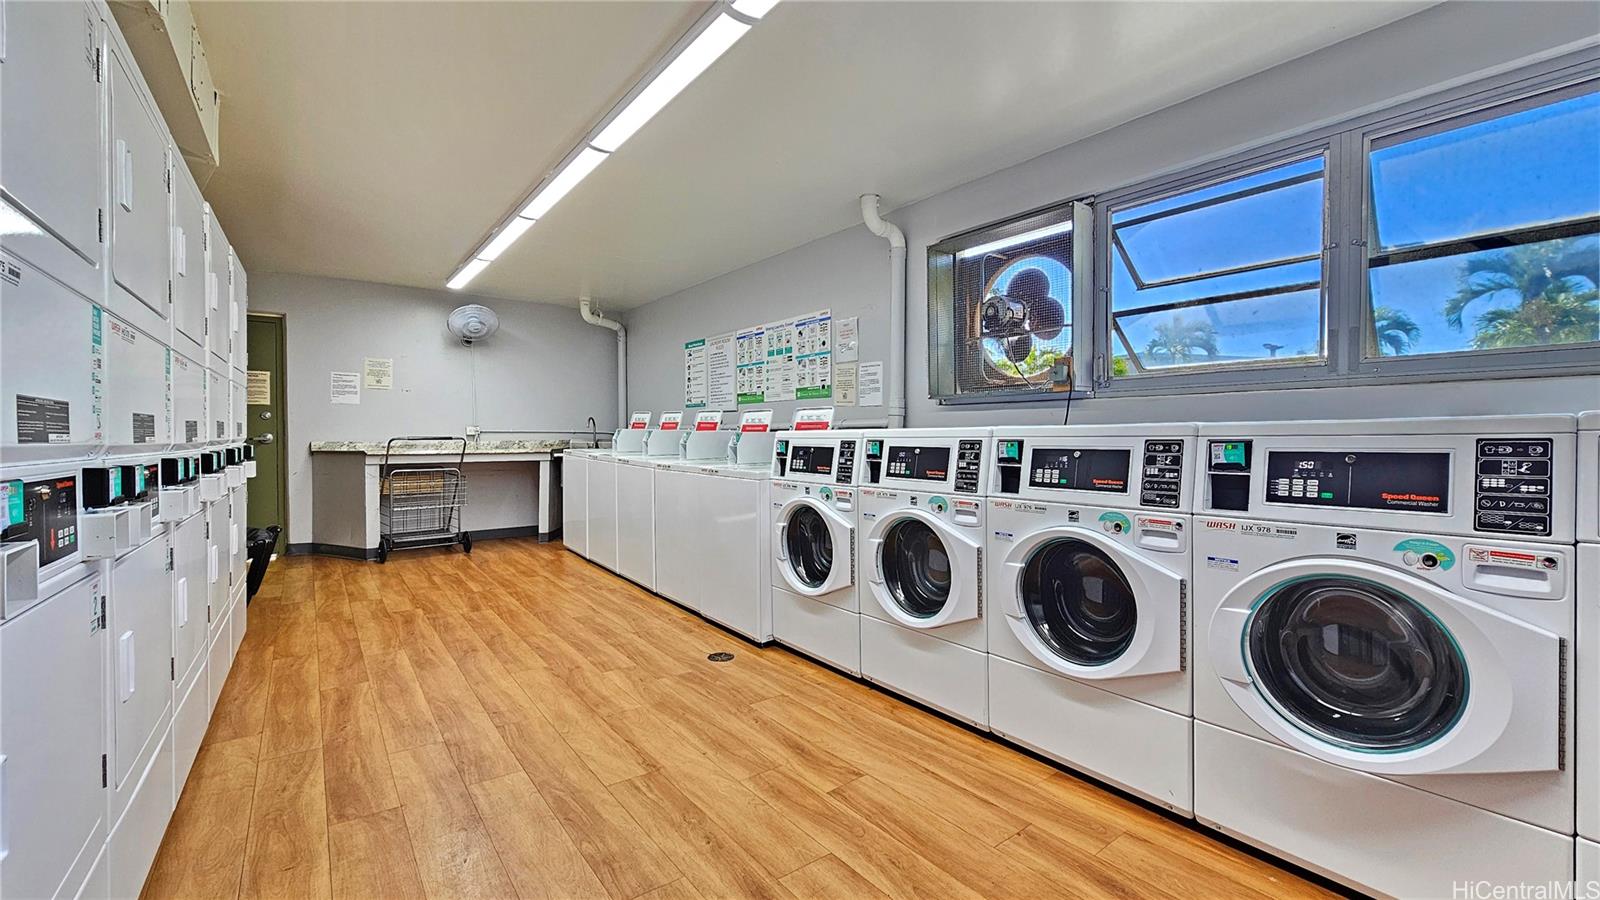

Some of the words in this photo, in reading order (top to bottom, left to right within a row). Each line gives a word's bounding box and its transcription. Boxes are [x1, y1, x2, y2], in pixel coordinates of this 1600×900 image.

[1381, 492, 1409, 500] Speed
[1410, 494, 1440, 502] Queen
[1206, 521, 1236, 530] WASH
